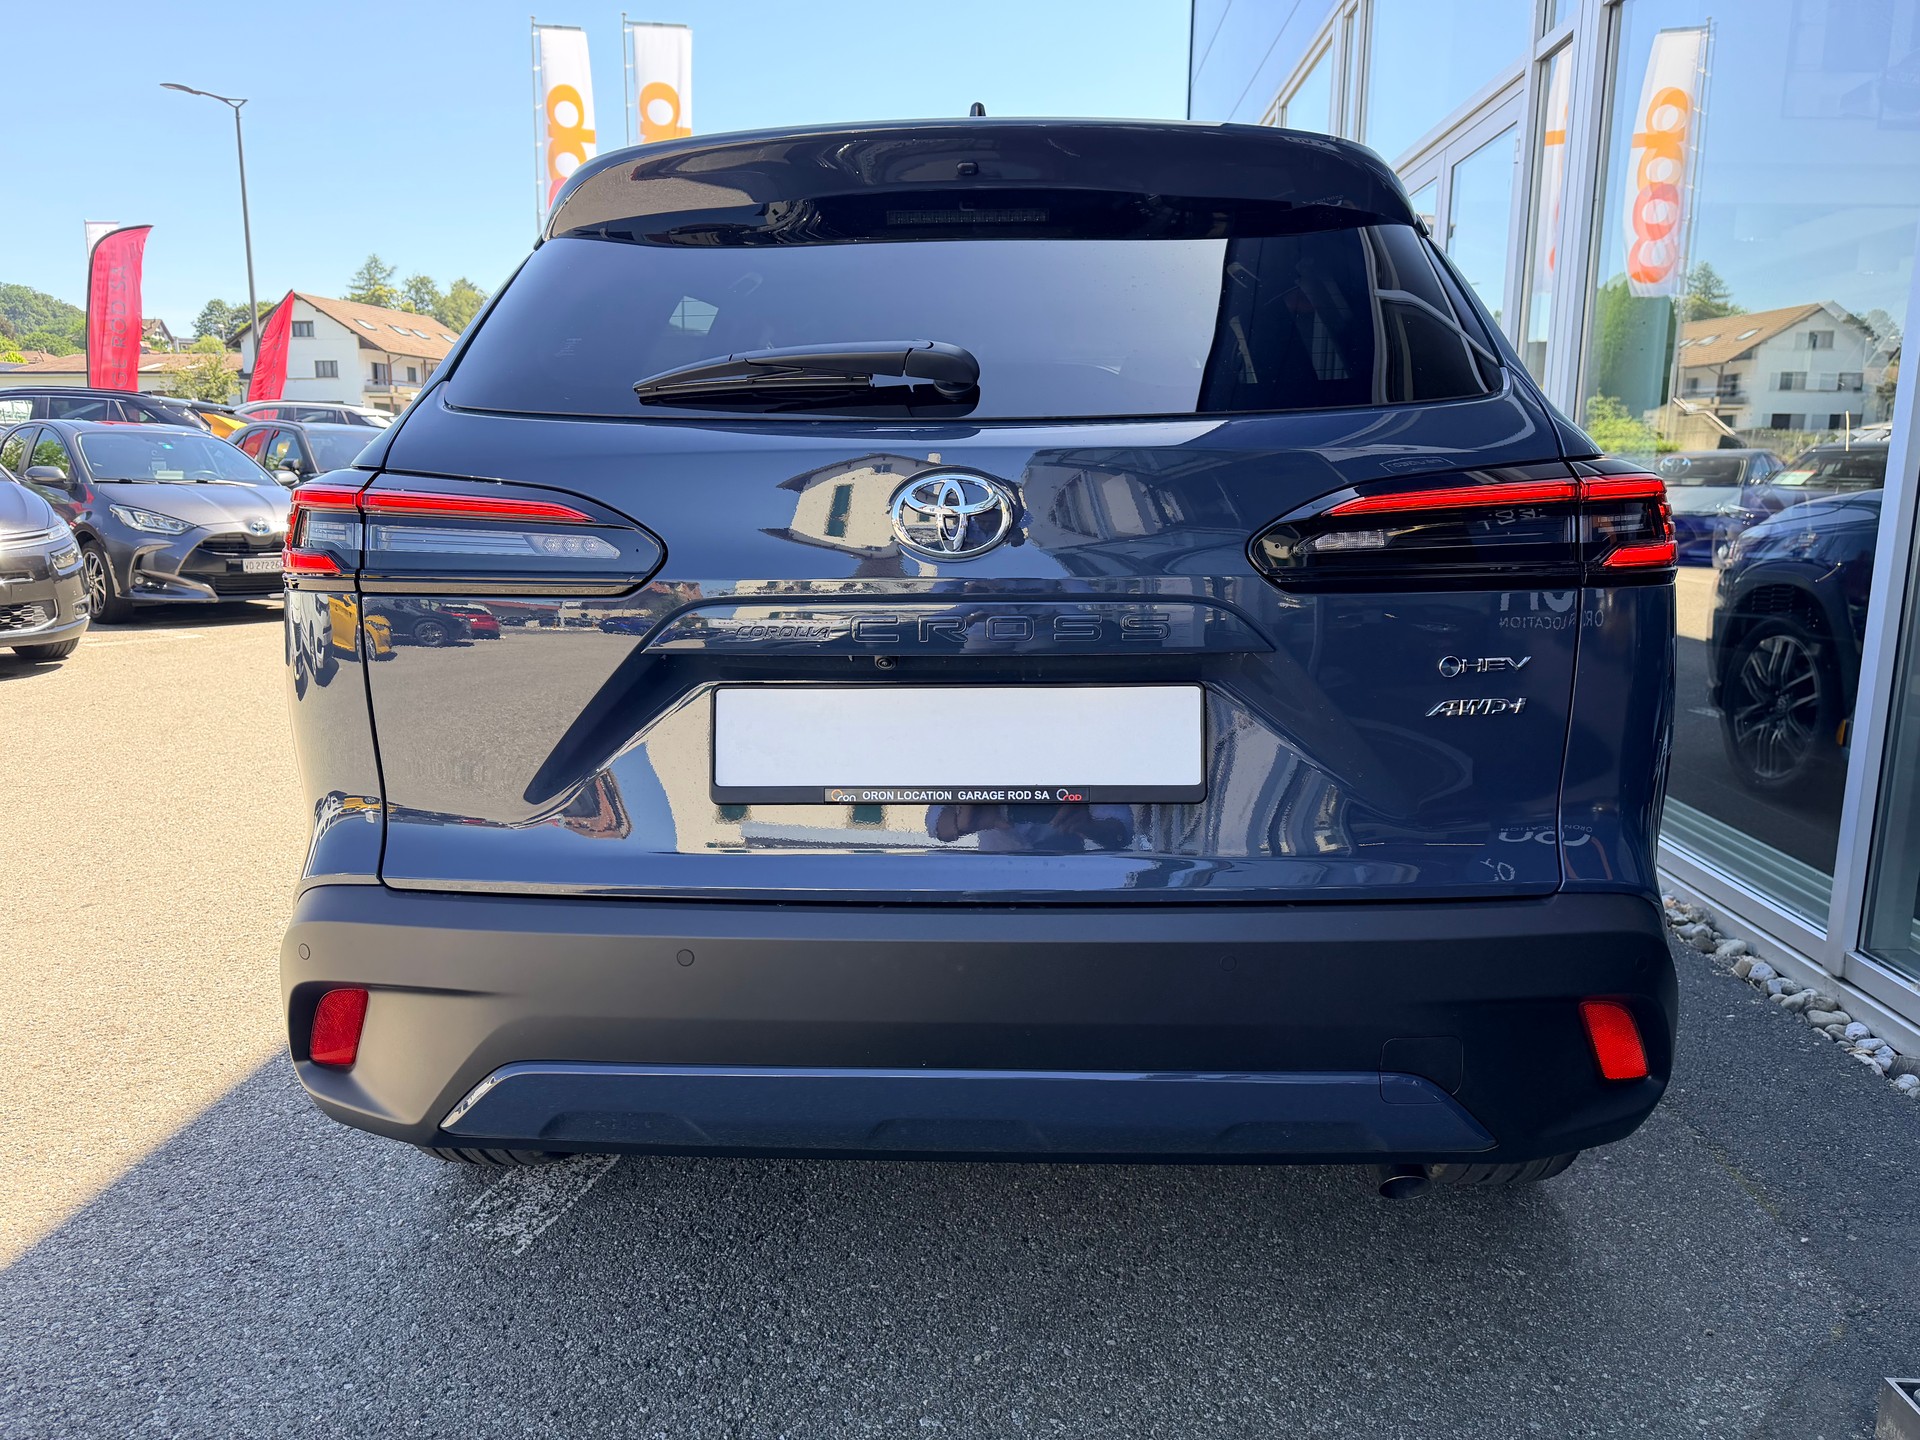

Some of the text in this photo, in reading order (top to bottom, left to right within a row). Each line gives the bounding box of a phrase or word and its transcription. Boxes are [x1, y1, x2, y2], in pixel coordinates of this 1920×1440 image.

[110, 265, 127, 292] SA
[110, 301, 127, 348] ROD
[735, 613, 1171, 643] COROLLA CROSS
[862, 790, 894, 801] ORON
[897, 790, 952, 801] LOCATION
[957, 790, 1005, 801] GARAGE
[1007, 790, 1032, 801] ROD
[1034, 789, 1050, 801] SA
